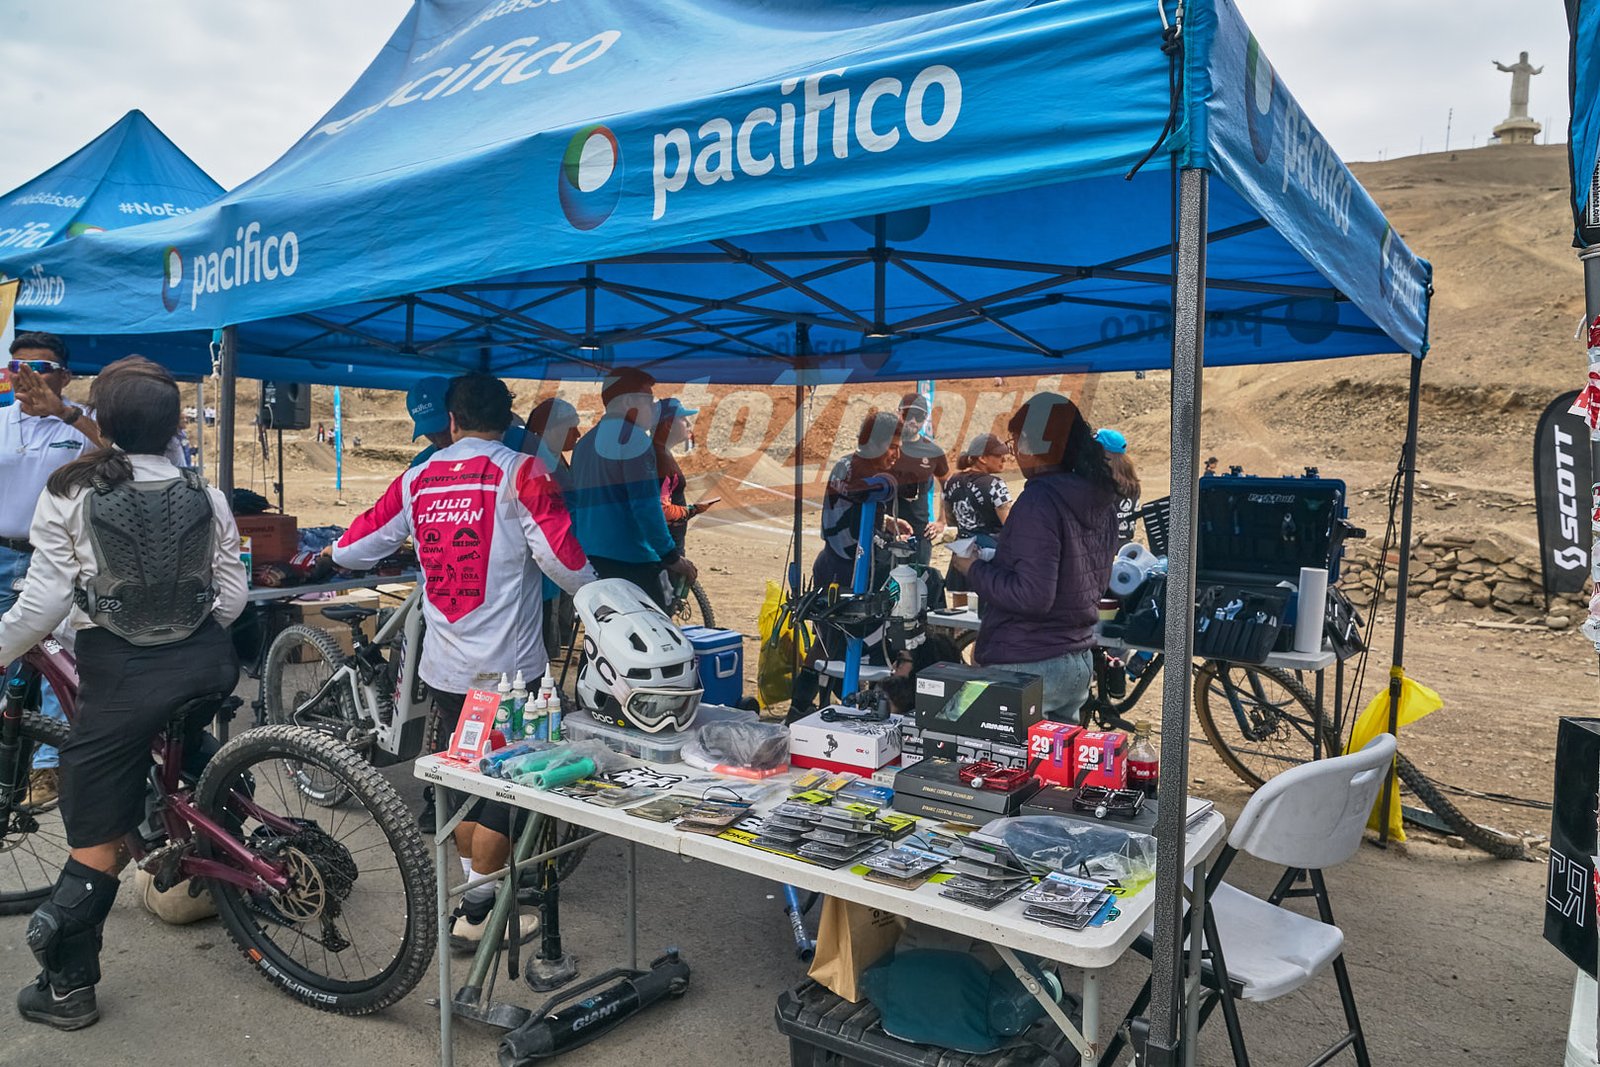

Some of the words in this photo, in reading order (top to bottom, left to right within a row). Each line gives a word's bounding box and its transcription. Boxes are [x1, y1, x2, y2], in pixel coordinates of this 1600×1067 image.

[1554, 424, 1579, 545] SCOTT
[591, 710, 614, 724] POC
[424, 771, 443, 782] MAGURA
[495, 790, 516, 801] MAGURA
[260, 958, 338, 1005] SCHWALBE
[572, 1000, 621, 1032] GIANT
